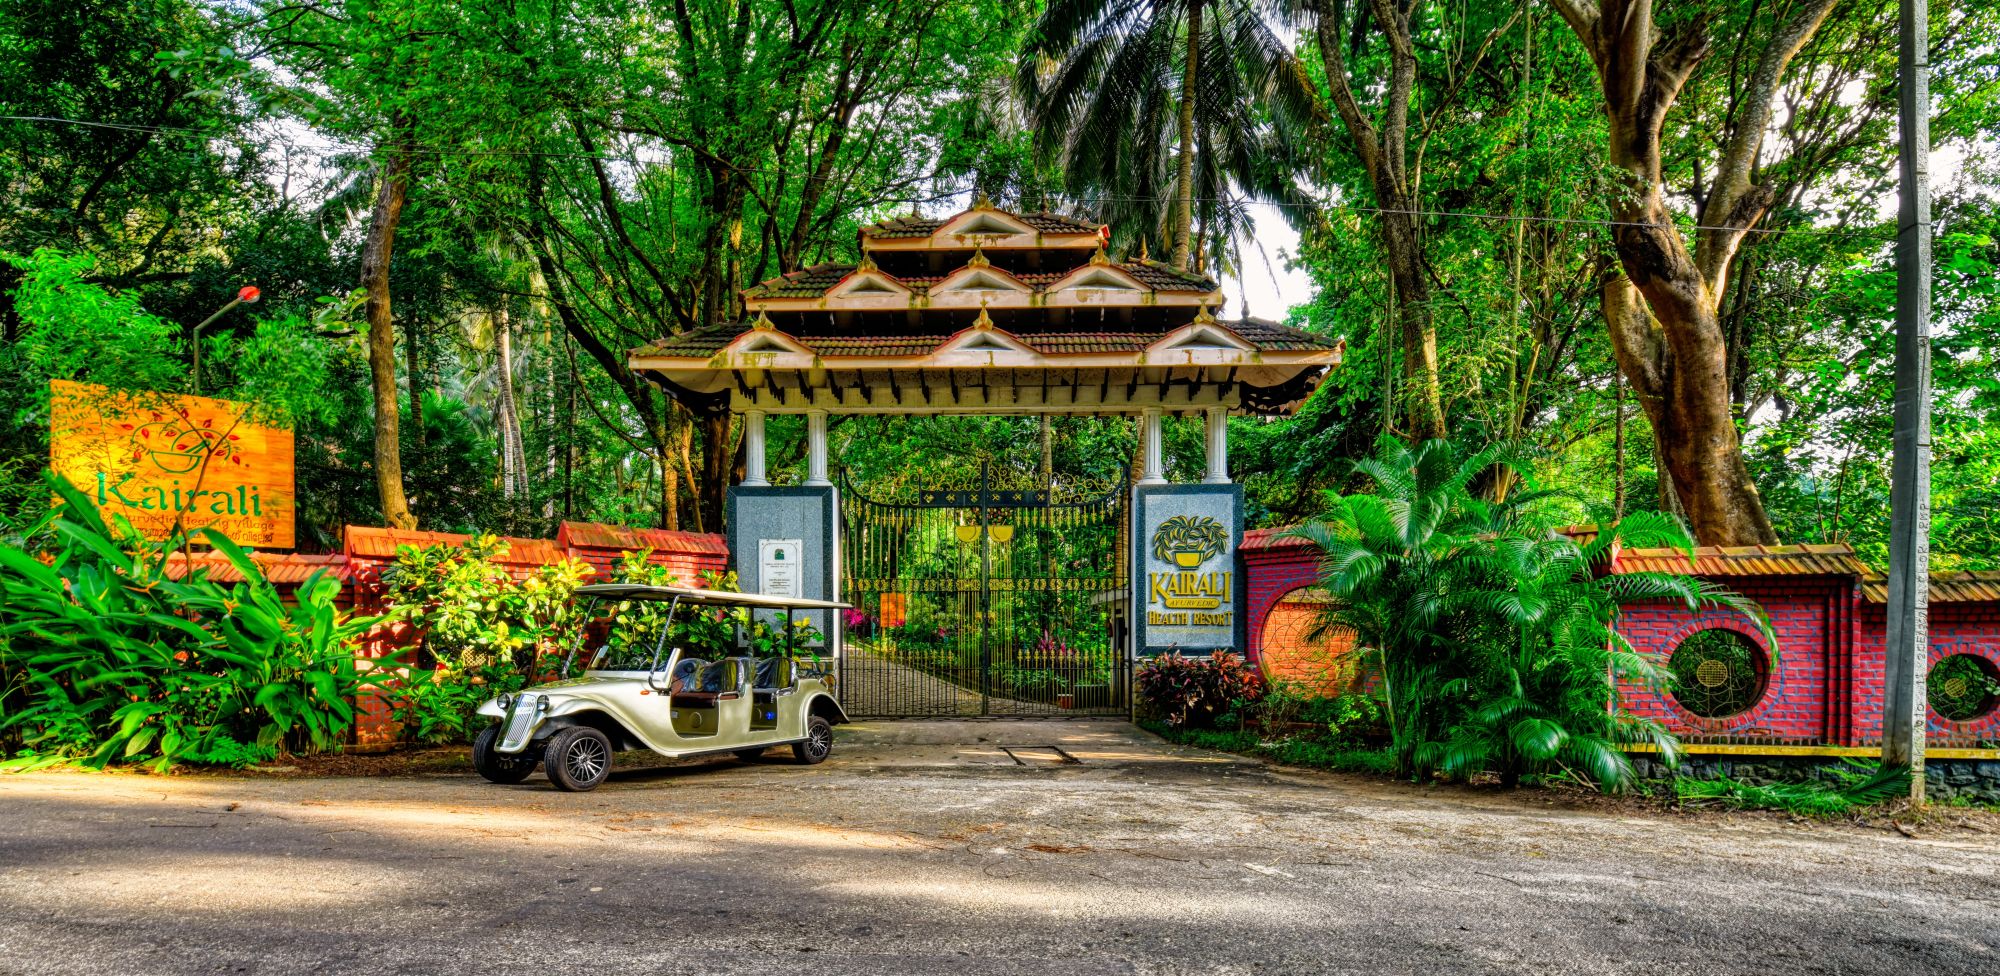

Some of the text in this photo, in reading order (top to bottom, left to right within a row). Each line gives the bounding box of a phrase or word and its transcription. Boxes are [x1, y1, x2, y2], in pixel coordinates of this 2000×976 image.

[96, 472, 262, 517] Kairali
[183, 516, 229, 531] Healng
[233, 517, 274, 532] Village
[1149, 571, 1232, 603] KAIRALI
[1170, 599, 1217, 607] AYURVEDIC
[1148, 611, 1232, 626] HEALTH RESORT
